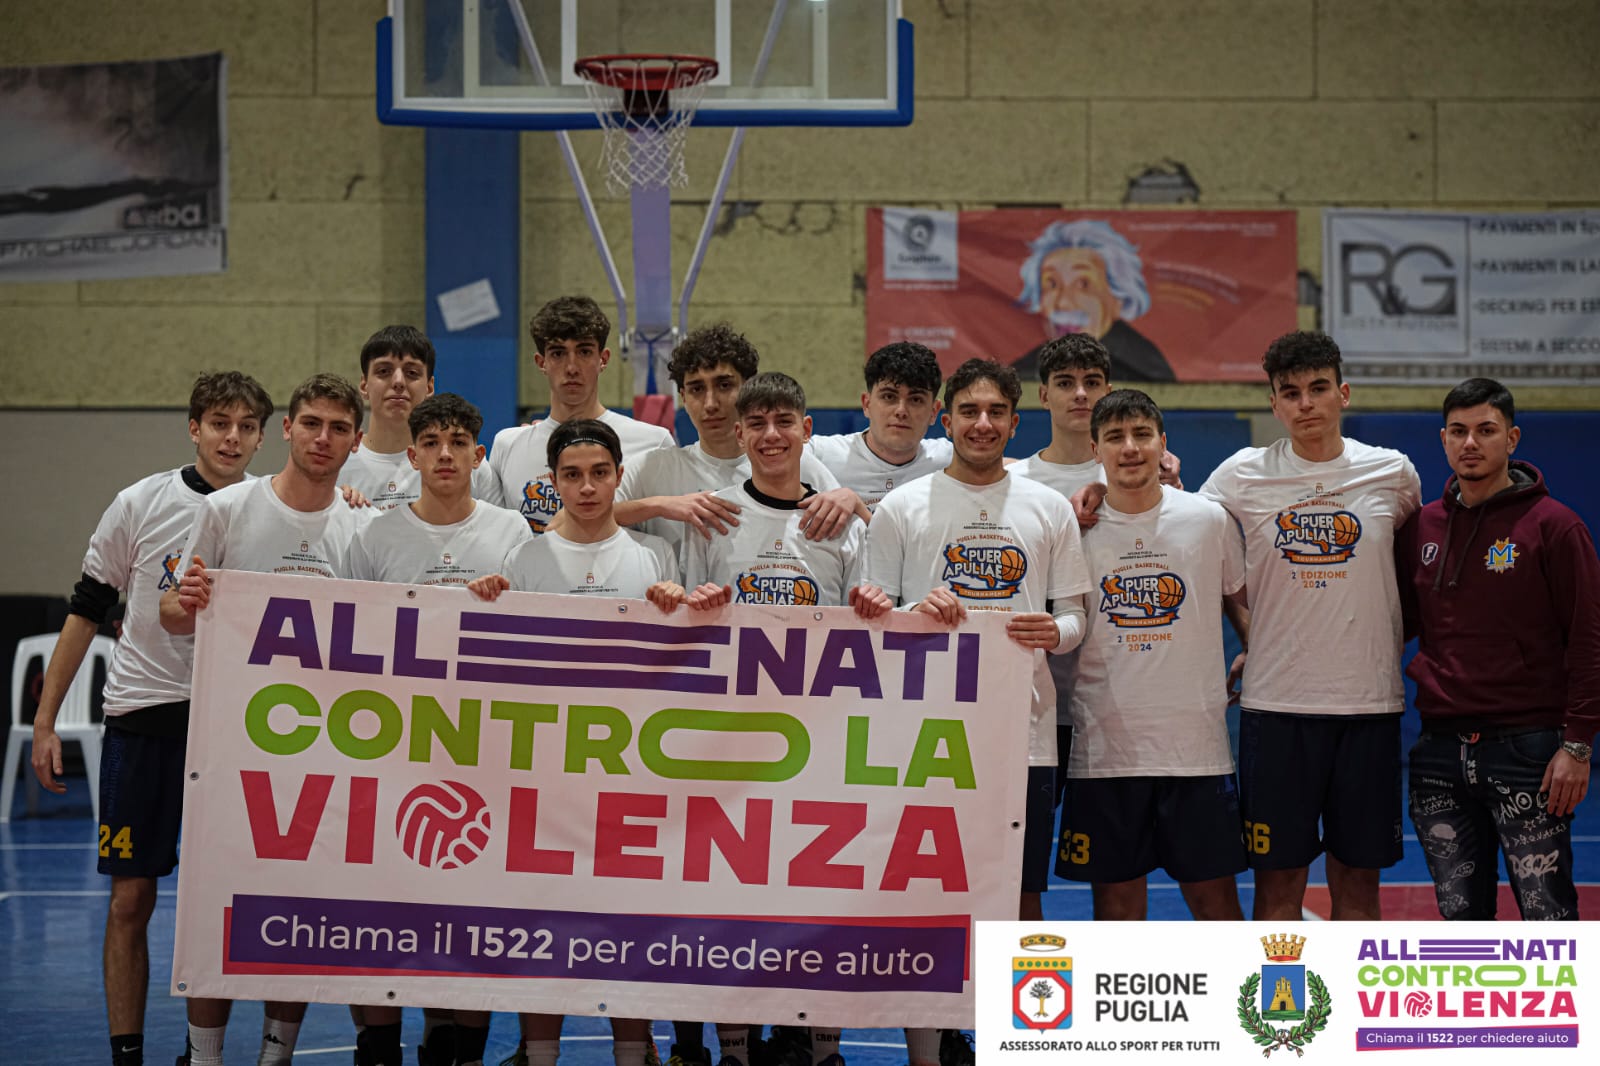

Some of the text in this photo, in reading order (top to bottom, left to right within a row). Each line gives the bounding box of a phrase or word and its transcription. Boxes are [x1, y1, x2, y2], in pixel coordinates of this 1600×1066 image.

[1480, 258, 1557, 273] PAVIMENTI
[1561, 258, 1576, 273] IN
[1480, 298, 1546, 313] DECKING
[521, 500, 560, 513] APULI
[1301, 515, 1334, 529] PUER
[1276, 529, 1336, 546] APULIAE
[968, 549, 1002, 564] PUER
[944, 563, 1003, 581] APULIAE
[1300, 570, 1348, 579] EDIZIONE
[761, 579, 795, 594] PUER
[1125, 577, 1159, 591] PUER
[1303, 580, 1327, 589] 2024
[1102, 591, 1160, 611] APULIAE
[1126, 633, 1172, 642] EDIZIONE
[247, 597, 980, 702] ALLENATI
[1128, 643, 1152, 651] 2024
[245, 683, 977, 789] CONTRO LA
[240, 770, 969, 892] VIOLENZA
[99, 824, 133, 858] 24
[1060, 829, 1091, 865] 33
[260, 914, 935, 975] Chiama il 1522 per chiedere aiuto
